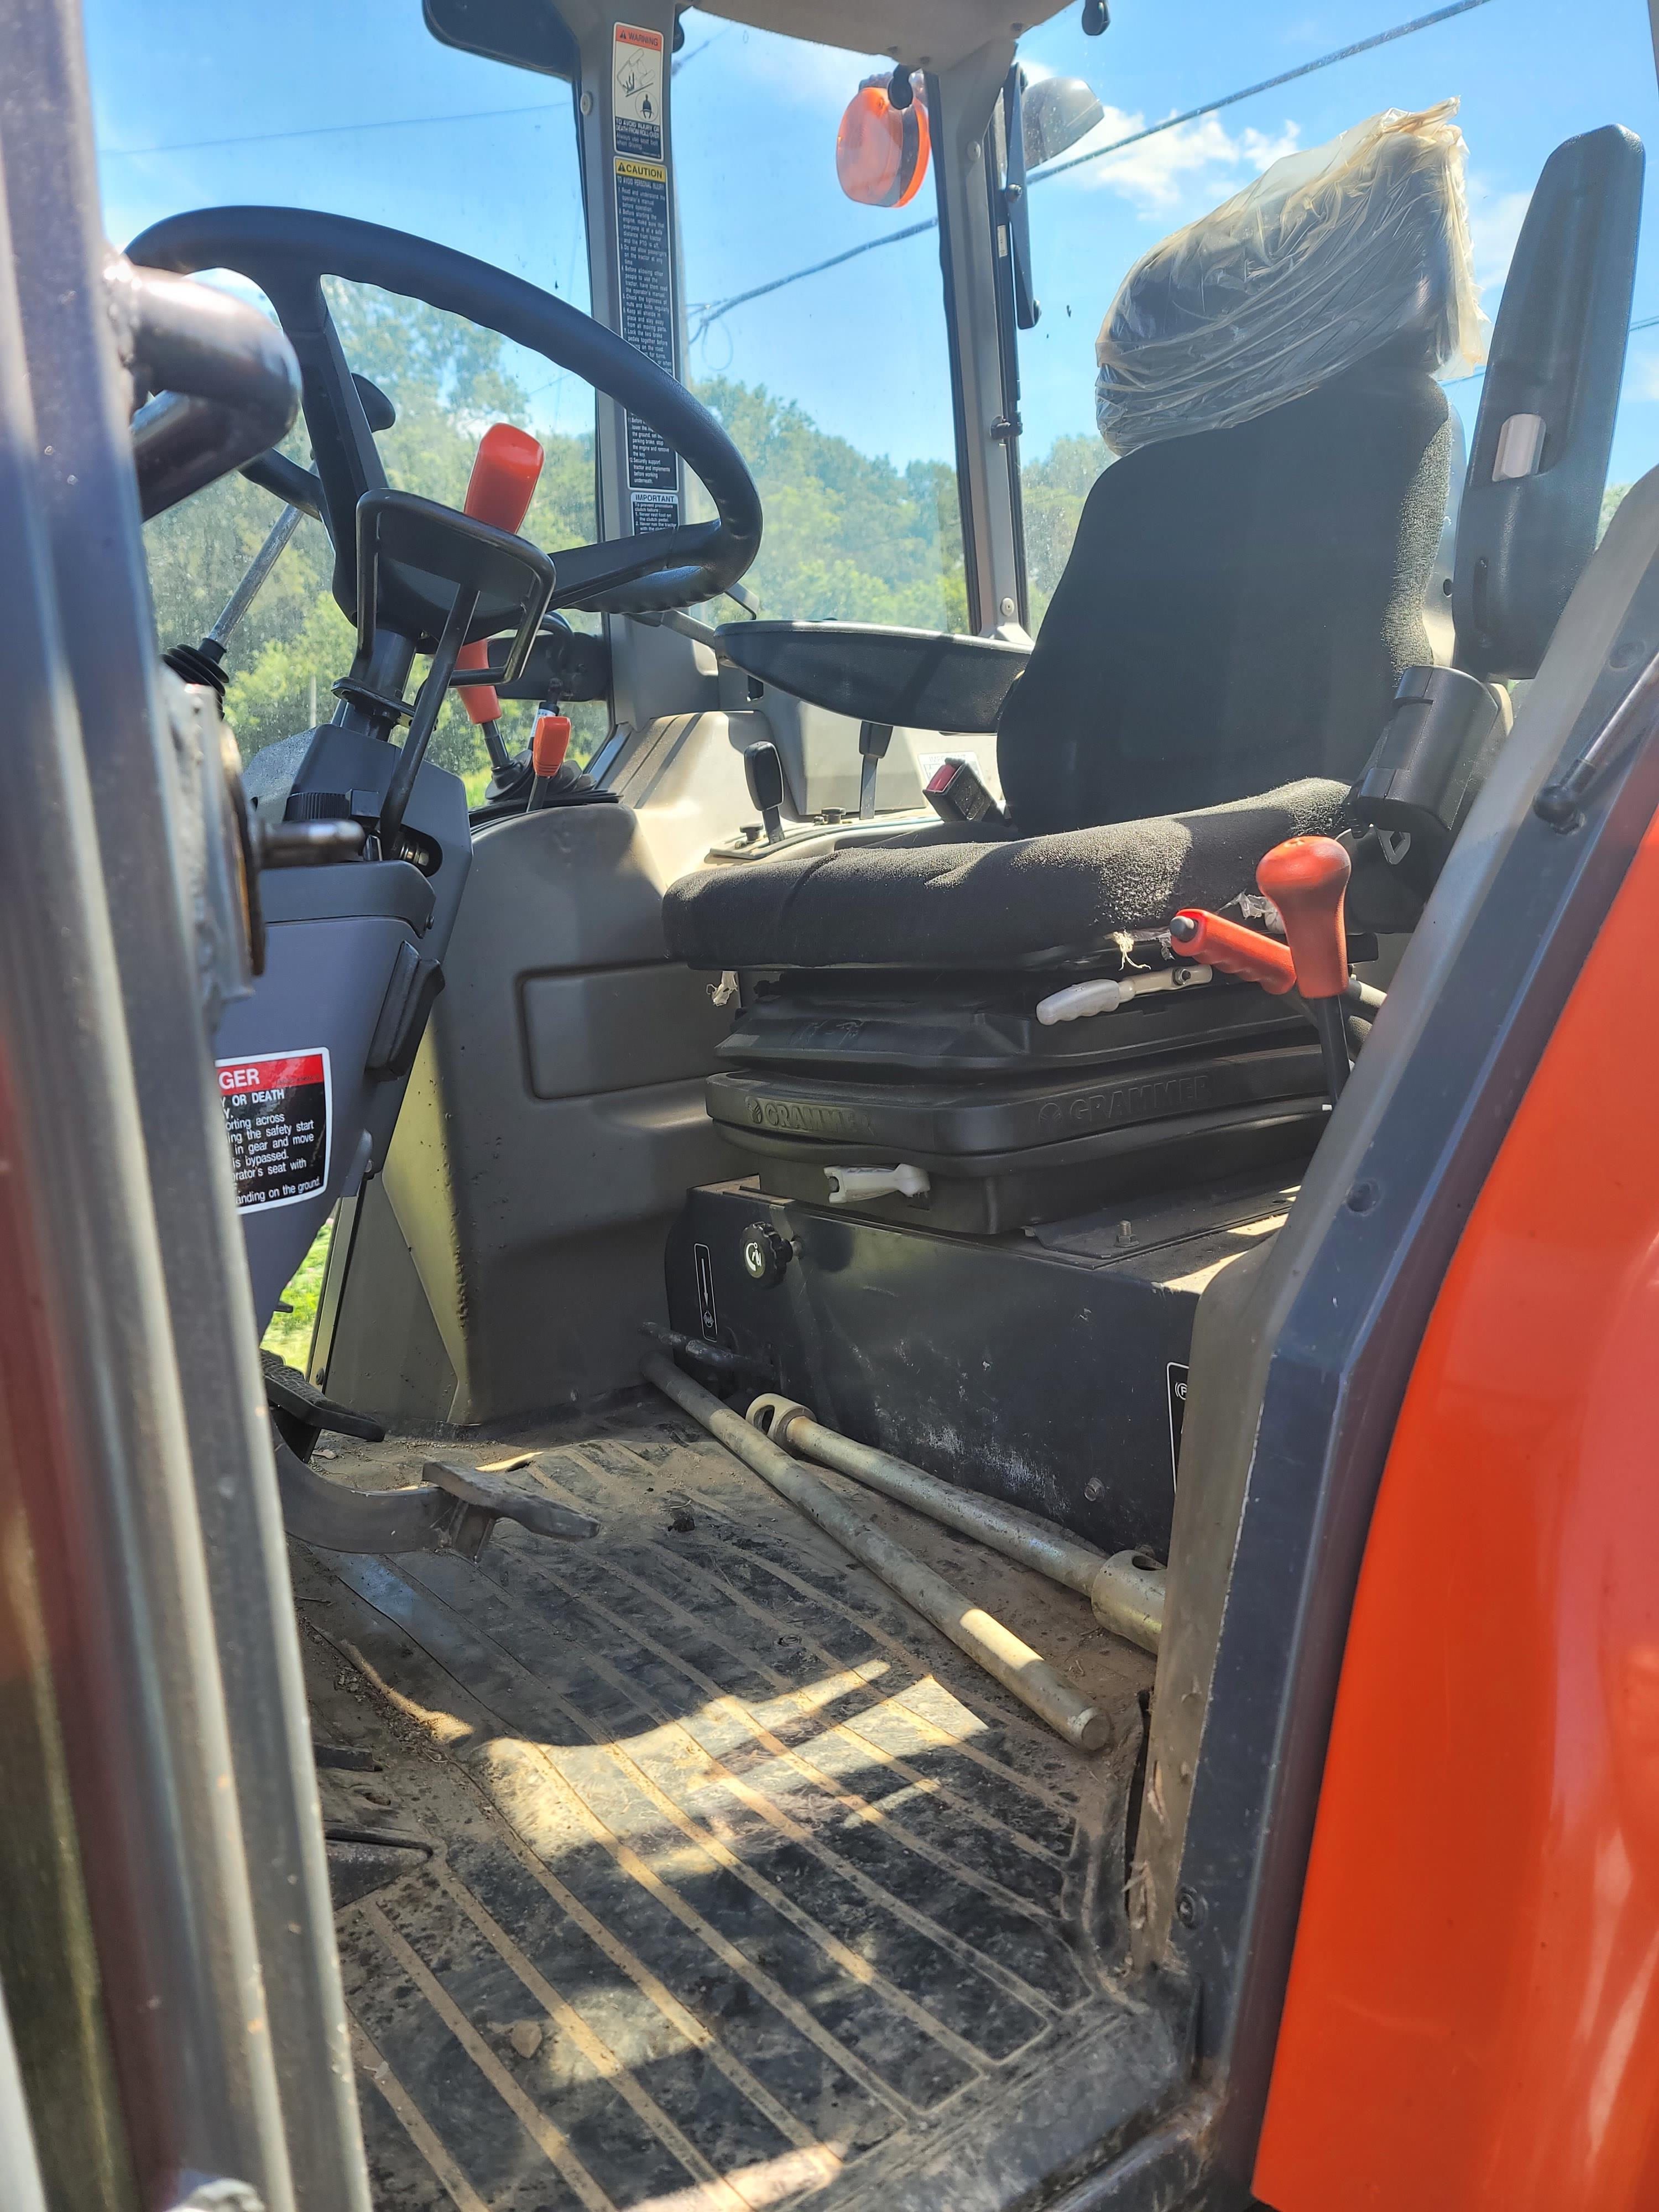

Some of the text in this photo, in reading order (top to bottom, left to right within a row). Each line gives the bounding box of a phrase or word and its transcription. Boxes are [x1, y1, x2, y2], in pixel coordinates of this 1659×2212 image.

[628, 32, 658, 46] WARNING
[626, 164, 662, 179] CAUTION
[232, 1094, 247, 1107] OR
[252, 1088, 285, 1104] DEATH
[1070, 1076, 1211, 1122] GRAMMER
[256, 1114, 285, 1126] across
[765, 1103, 872, 1133] GRAMMER
[247, 1129, 262, 1140] the
[266, 1124, 292, 1137] safety
[296, 1119, 314, 1132] start
[234, 1133, 314, 1155] in gear and move
[232, 1148, 289, 1168] is bypassed.
[268, 1162, 286, 1175] seat
[290, 1157, 306, 1170] with
[268, 1188, 280, 1198] on
[283, 1184, 296, 1195] the
